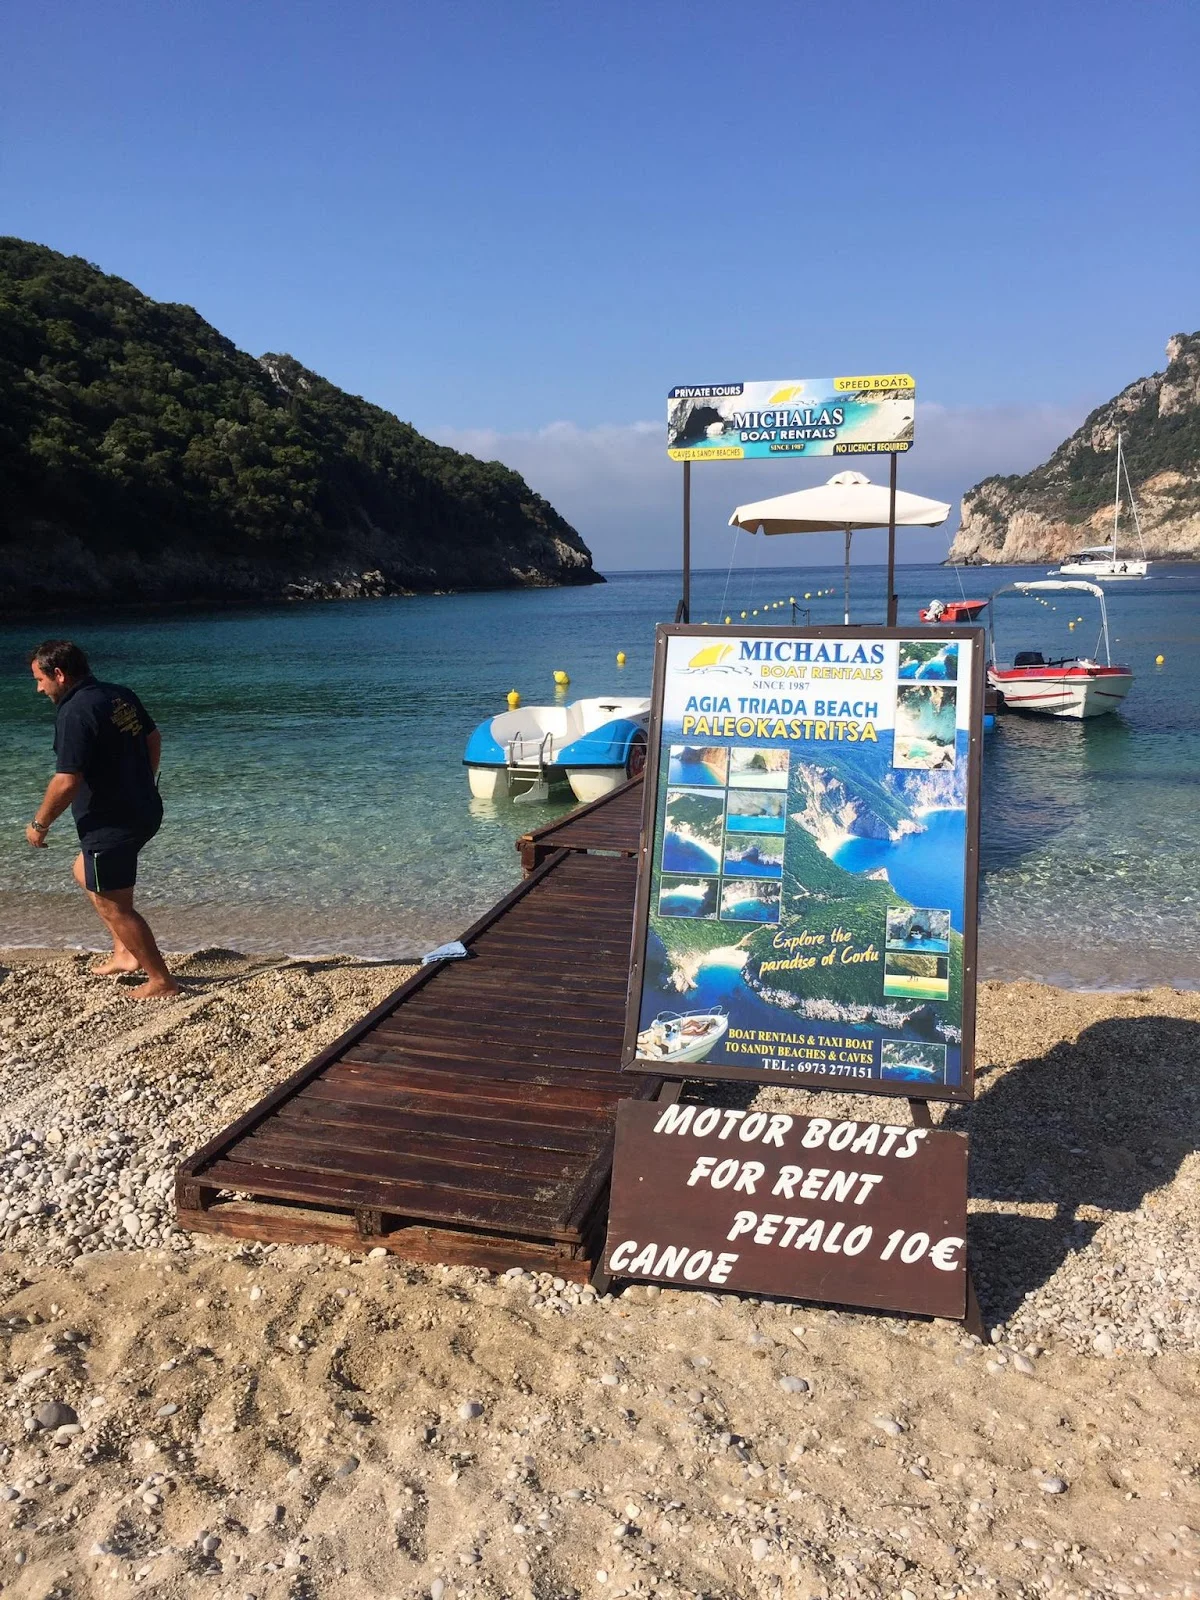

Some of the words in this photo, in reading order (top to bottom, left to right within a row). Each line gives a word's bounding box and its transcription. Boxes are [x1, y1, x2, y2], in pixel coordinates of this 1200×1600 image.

[675, 387, 710, 398] PRIVATE
[711, 386, 741, 397] TOURS
[839, 380, 871, 389] SPEED
[874, 377, 908, 388] BOATS
[733, 408, 843, 429] MICHALAS
[741, 431, 776, 442] BOAT
[780, 428, 836, 440] RENTALS
[672, 450, 691, 459] CAVES
[696, 449, 715, 458] SANDY
[716, 448, 741, 457] BEACHES
[836, 444, 847, 453] NO
[848, 443, 876, 453] LICENCE
[876, 442, 909, 452] REQUIRED
[738, 641, 885, 664] MICHALAS
[760, 665, 807, 679] BOAT
[811, 667, 883, 681] RENTALS
[752, 680, 785, 690] SINCE
[788, 681, 810, 691] 1987
[684, 696, 731, 714] AGIA
[737, 697, 808, 716] TRIADA
[814, 700, 878, 718] BEACH
[681, 715, 878, 743] PALEOKASTRITSA
[773, 930, 825, 954] Explore
[830, 926, 852, 943] the
[758, 952, 816, 979] paradise
[821, 948, 837, 966] of
[841, 944, 879, 964] Corfu
[728, 1028, 756, 1040] BOAT
[758, 1031, 805, 1045] RENTALS
[807, 1035, 816, 1046] &
[818, 1036, 844, 1048] TAXI
[845, 1038, 874, 1050] BOAT
[725, 1041, 739, 1053] TO
[740, 1042, 777, 1056] SANDY
[778, 1046, 826, 1060] BEACHES
[828, 1051, 837, 1061] &
[839, 1052, 873, 1064] CAVES
[762, 1058, 795, 1072] TEL:
[797, 1061, 826, 1075] 6973
[829, 1064, 872, 1079] 277151
[653, 1103, 793, 1148] MOTOR
[801, 1118, 928, 1159] BOATS
[686, 1155, 765, 1195] FOR
[771, 1164, 883, 1206] RENT
[726, 1210, 873, 1257] PETALO
[880, 1229, 965, 1271] 10€
[608, 1240, 740, 1284] CANOE
